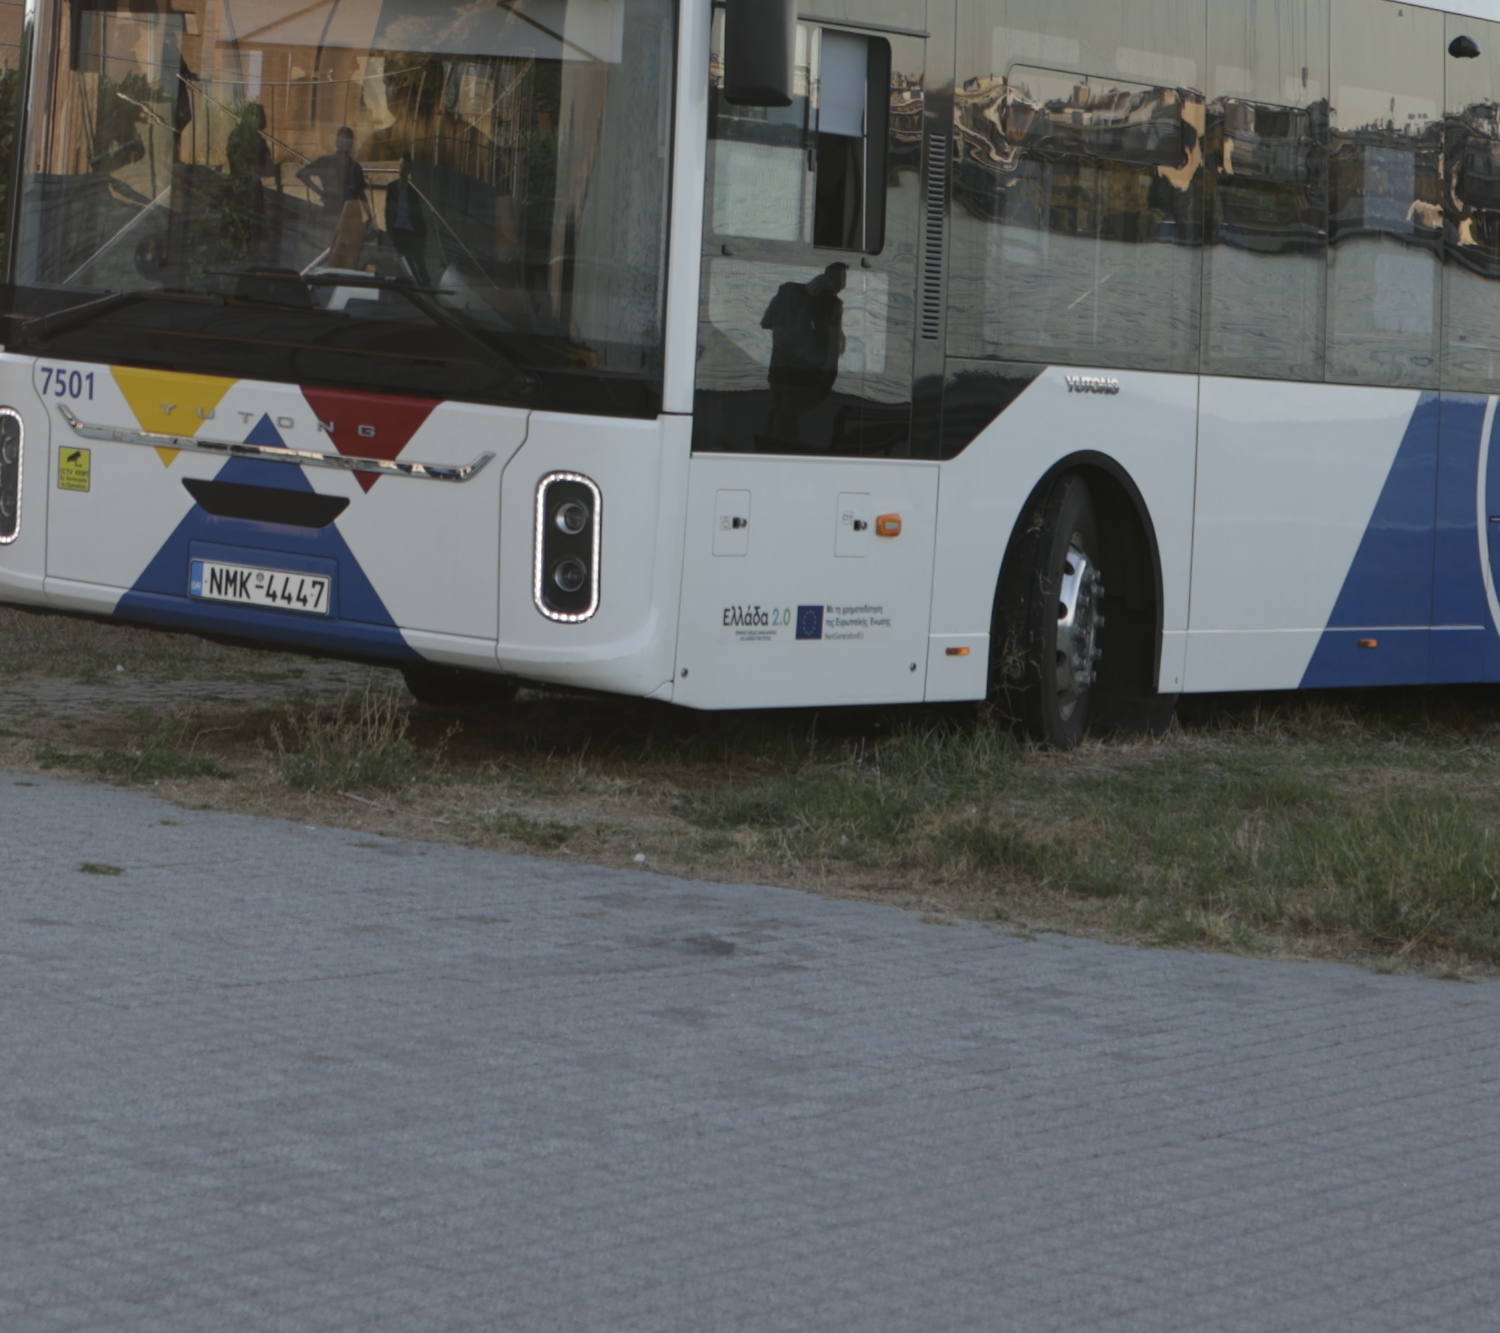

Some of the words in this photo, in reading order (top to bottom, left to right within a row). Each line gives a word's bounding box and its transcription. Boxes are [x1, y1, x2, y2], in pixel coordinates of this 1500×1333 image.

[40, 366, 94, 401] 7501
[160, 403, 377, 438] YUTONG
[209, 567, 325, 608] NMK-4447
[723, 605, 769, 626] Ελλάδα
[772, 607, 791, 626] 2.0
